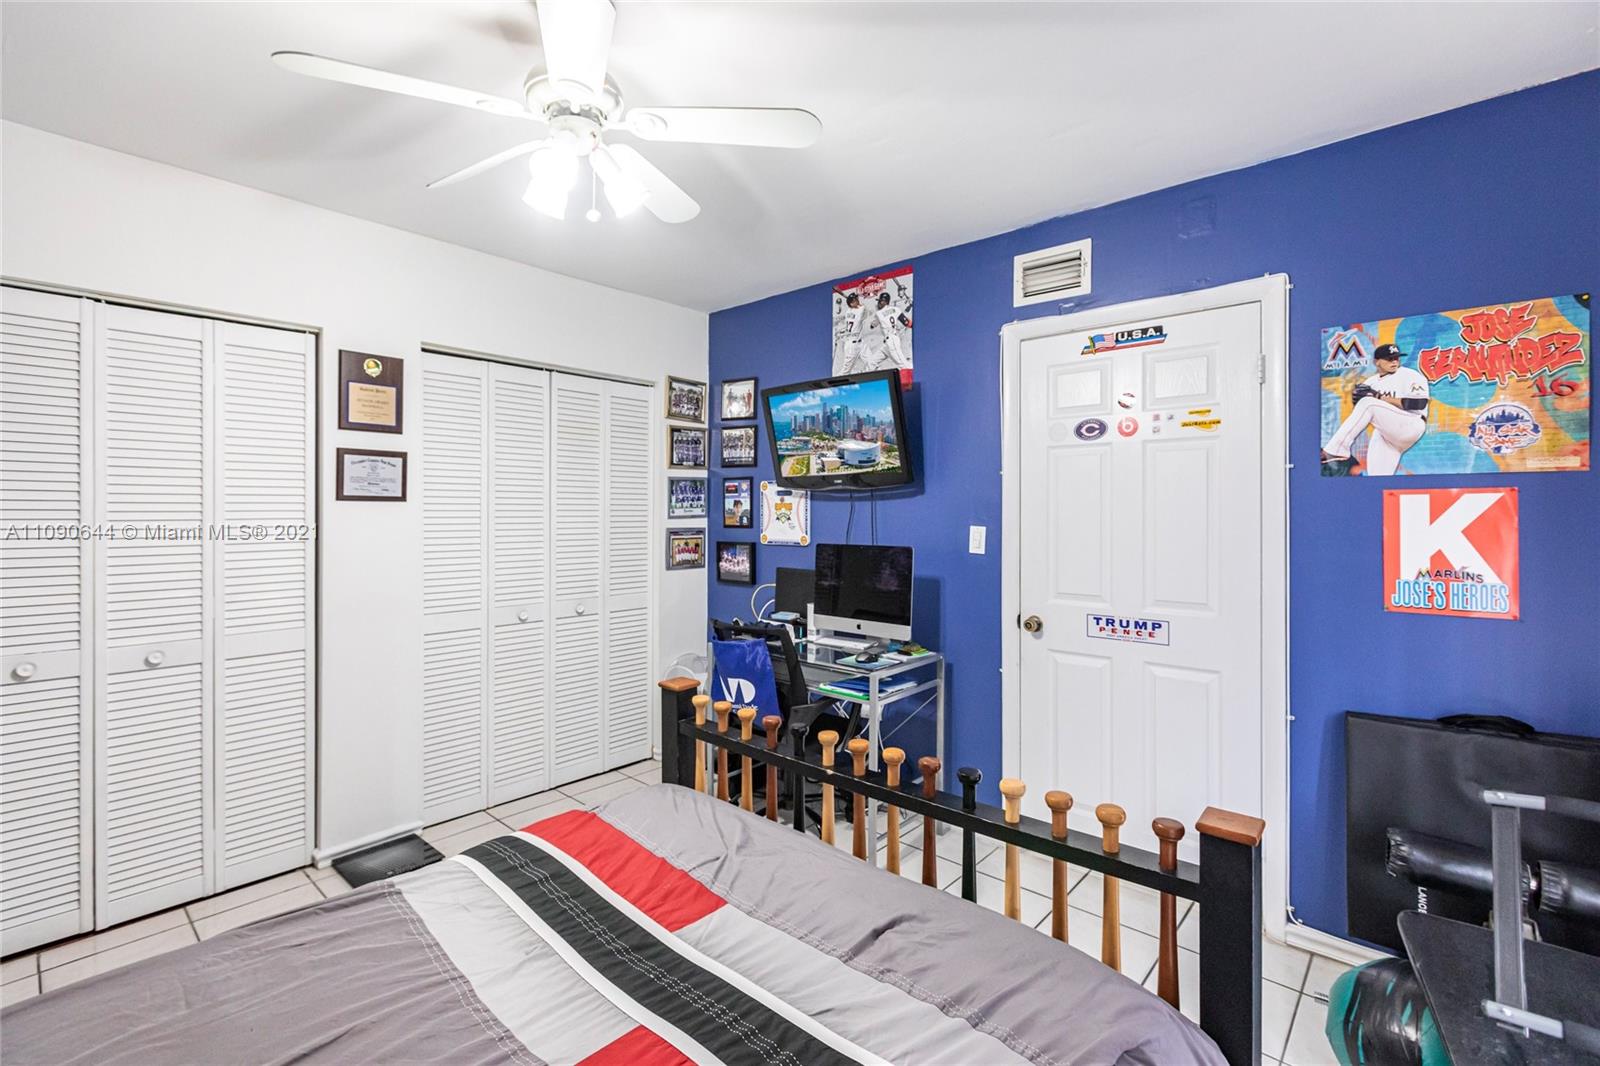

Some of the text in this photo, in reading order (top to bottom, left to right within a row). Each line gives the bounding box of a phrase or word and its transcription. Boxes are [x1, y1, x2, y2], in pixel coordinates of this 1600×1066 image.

[1459, 303, 1537, 344] JOSE
[1118, 328, 1161, 341] U.S.A.
[1325, 360, 1369, 369] MIAMI
[1418, 331, 1585, 386] FERNANDEZ
[1527, 374, 1580, 398] 16
[1498, 423, 1537, 436] STAR
[1415, 567, 1485, 584] MARLINS
[1392, 579, 1509, 612] JOSE'S HEROES
[1093, 617, 1162, 631] TRUMP
[1099, 626, 1156, 638] PENCE
